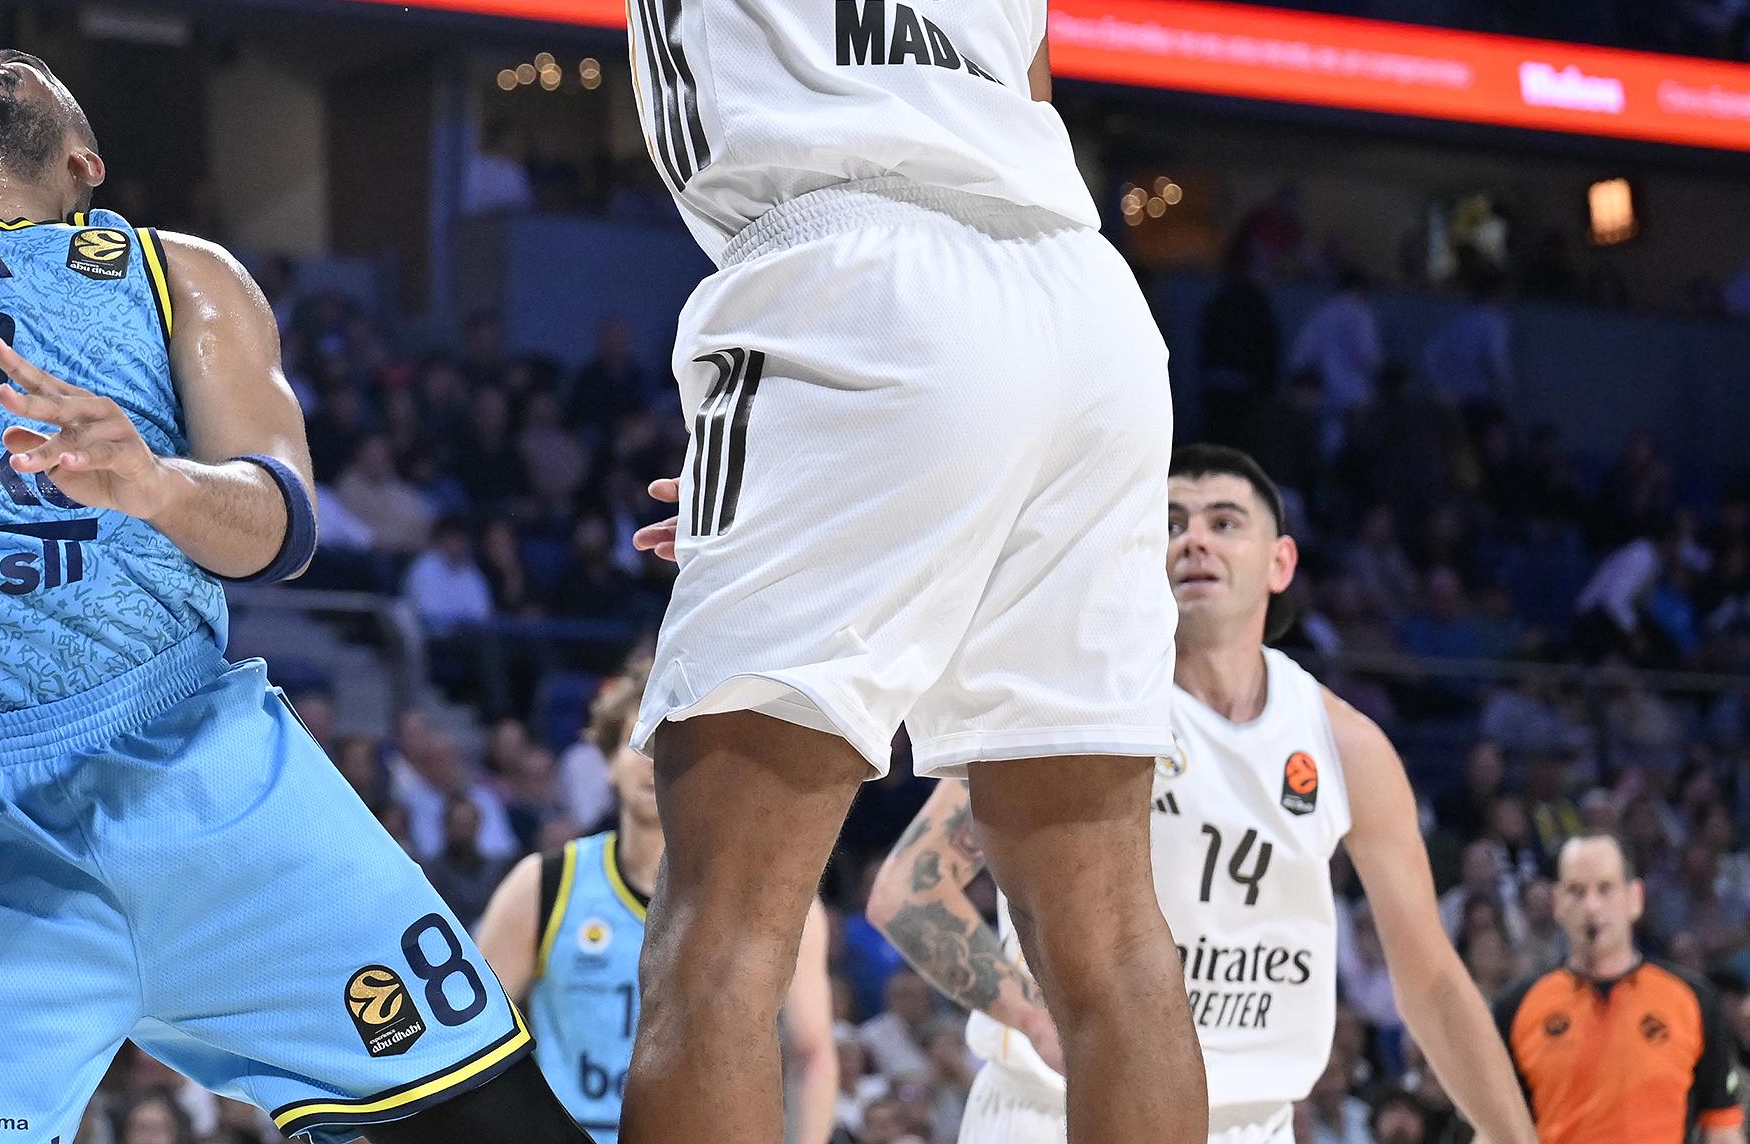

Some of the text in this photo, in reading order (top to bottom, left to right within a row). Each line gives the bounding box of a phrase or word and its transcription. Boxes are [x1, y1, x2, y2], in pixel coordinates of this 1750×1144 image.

[836, 0, 1007, 87] MAD
[69, 262, 90, 272] abu
[1200, 822, 1273, 906] 14
[401, 913, 488, 1027] 8
[1177, 935, 1312, 984] irates
[372, 1021, 422, 1053] abu dhabi
